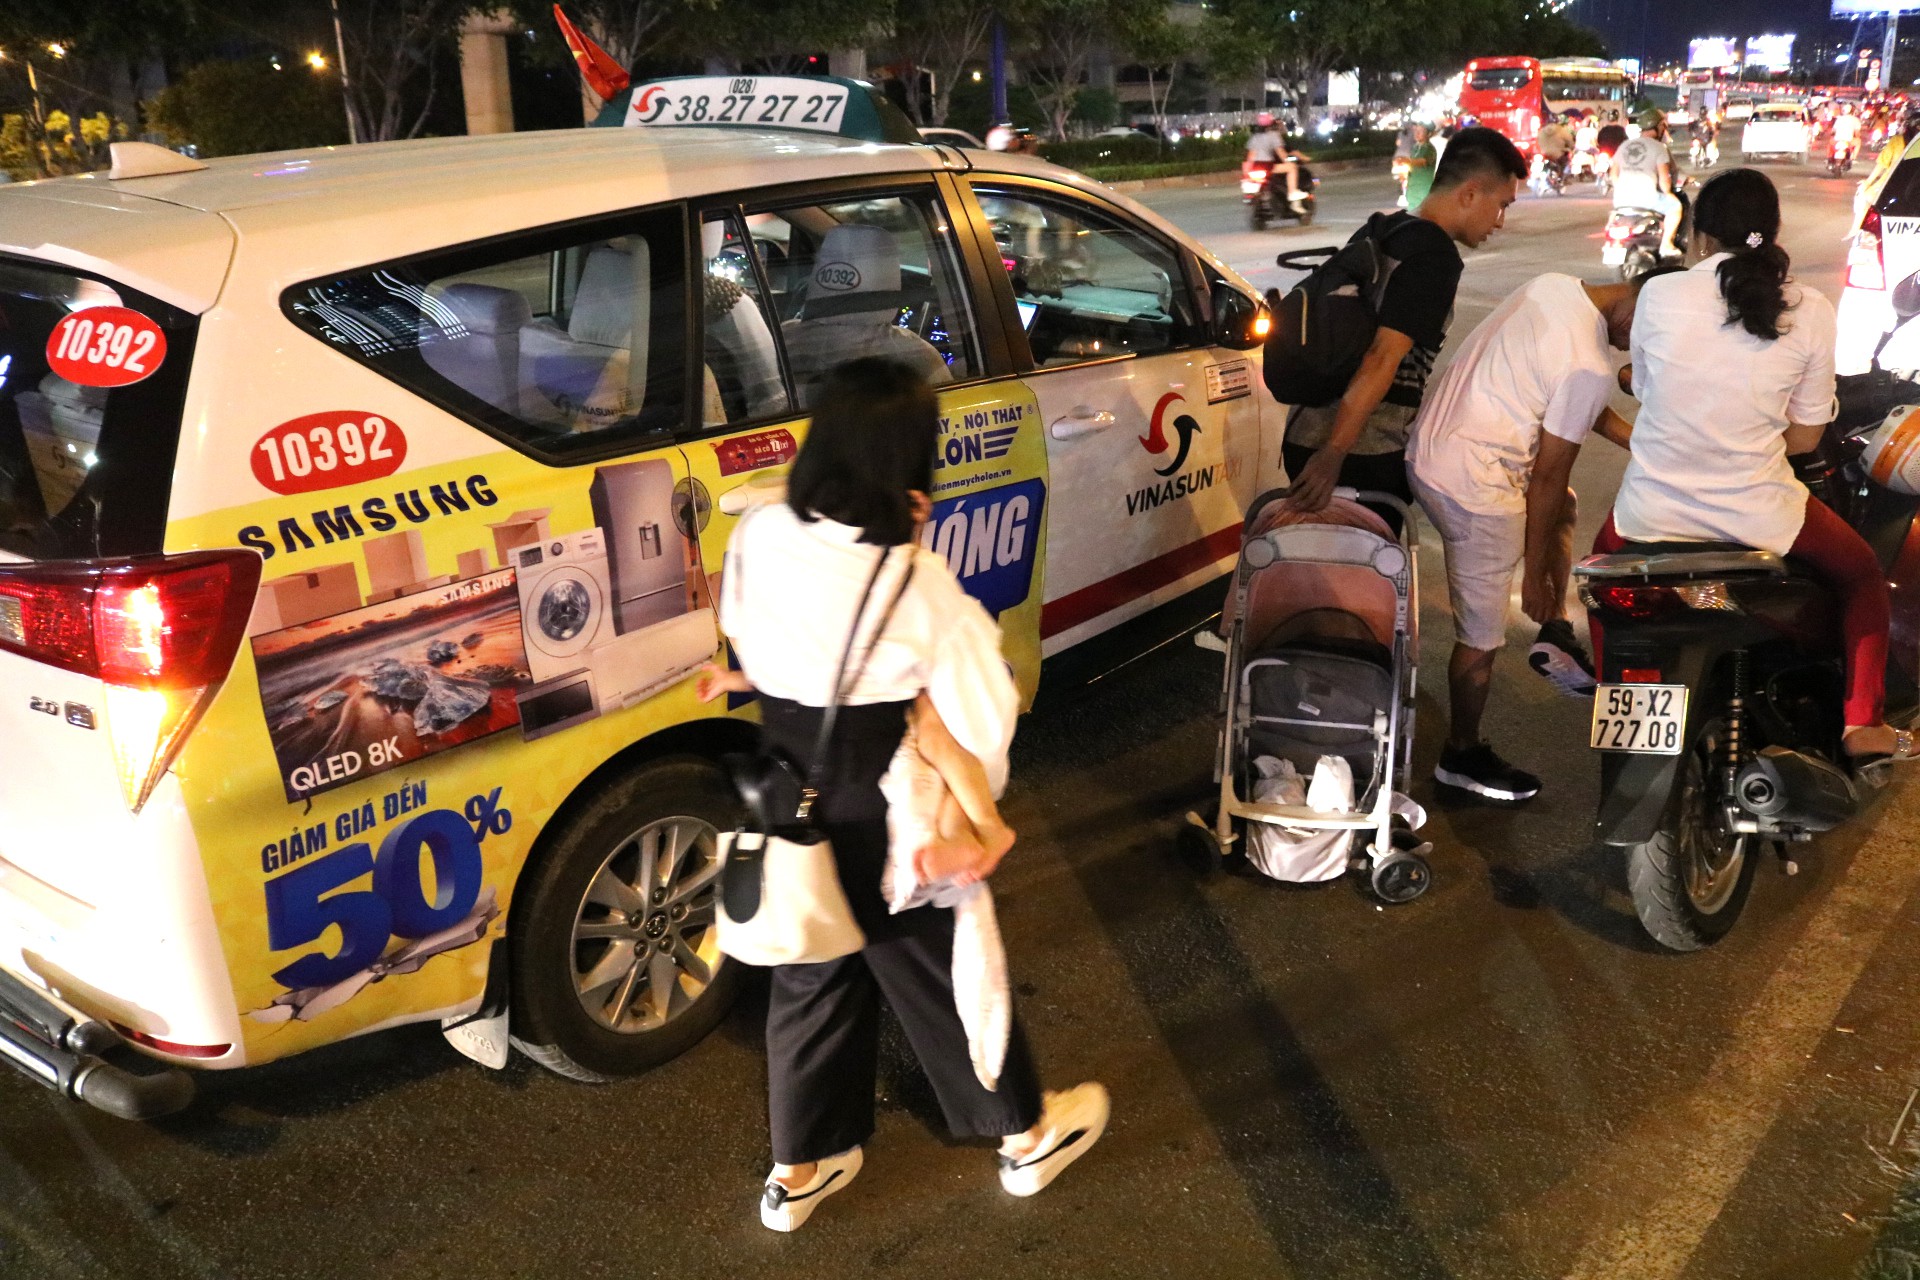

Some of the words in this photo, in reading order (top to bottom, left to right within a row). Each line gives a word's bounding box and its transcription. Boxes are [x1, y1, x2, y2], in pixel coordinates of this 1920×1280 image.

[728, 78, 758, 94] (028)
[674, 95, 755, 122] 38.27
[758, 95, 798, 122] 27
[801, 95, 843, 123] 27
[820, 268, 856, 286] 10392
[56, 318, 157, 373] 10392
[259, 416, 394, 482] 10392
[237, 474, 499, 560] SAMSUNG
[440, 575, 511, 605] SAMSUNG
[1608, 689, 1673, 717] 59-X2
[1596, 719, 1678, 749] 727.08
[290, 751, 362, 792] QLED
[368, 735, 403, 768] 8K
[261, 826, 327, 874] GIẢM
[335, 798, 377, 842] GIÁ
[383, 776, 427, 822] ĐẾN
